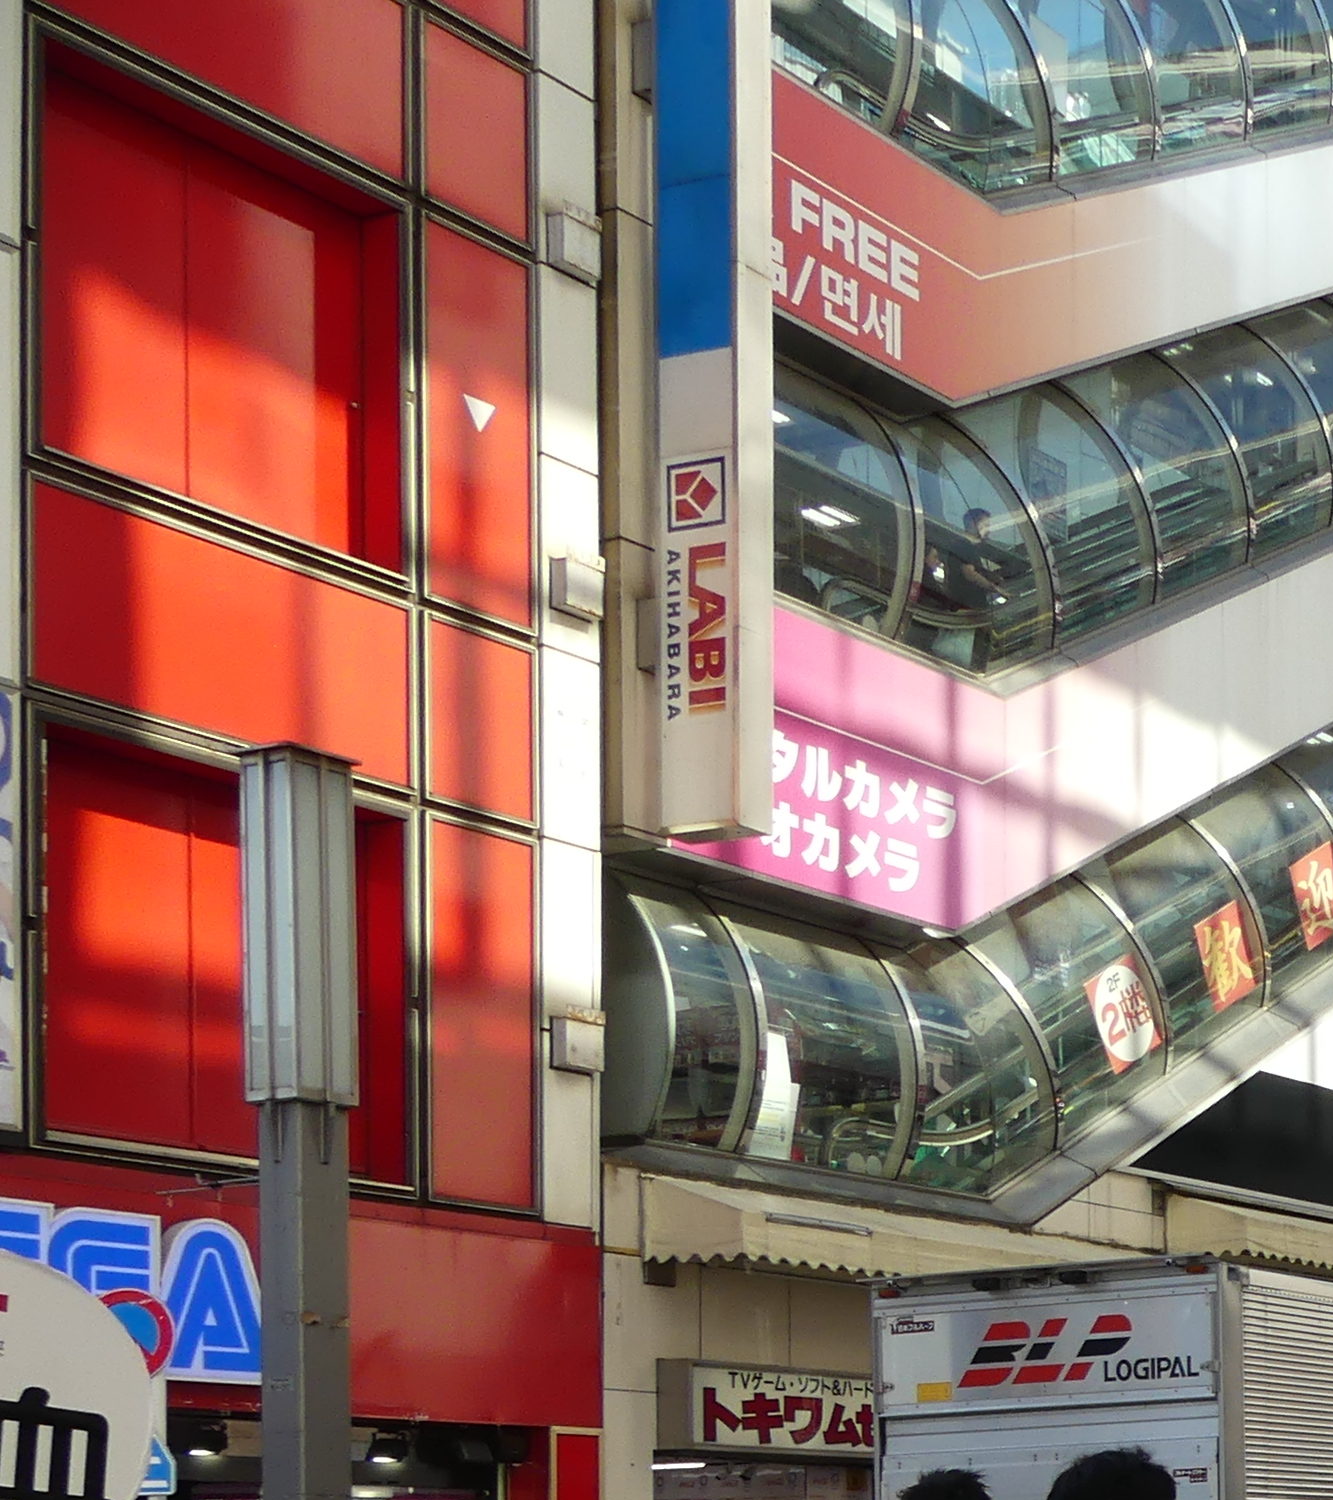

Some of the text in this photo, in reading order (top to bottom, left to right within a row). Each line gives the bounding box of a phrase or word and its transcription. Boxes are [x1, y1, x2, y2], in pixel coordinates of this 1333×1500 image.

[791, 180, 920, 301] FREE
[665, 549, 684, 723] AKIHABARA
[688, 542, 726, 715] LABI
[1103, 1355, 1200, 1383] LOGIPAL
